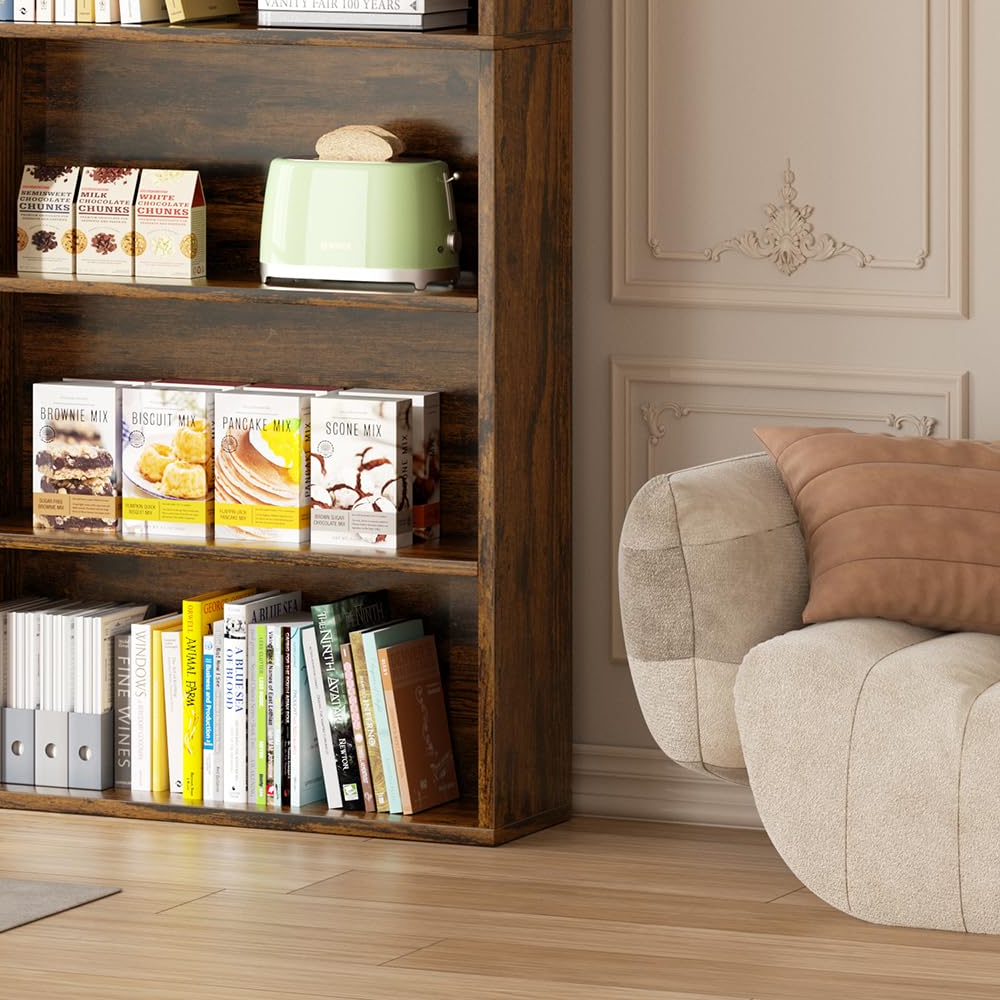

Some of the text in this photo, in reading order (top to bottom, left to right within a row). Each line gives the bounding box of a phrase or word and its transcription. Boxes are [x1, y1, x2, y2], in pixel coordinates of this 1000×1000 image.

[363, 0, 401, 11] YEARS
[20, 203, 70, 211] CHUNKS
[78, 205, 130, 214] CHUNKS
[137, 207, 189, 215] CHUNKS
[40, 406, 108, 423] BROWNIE MIX
[132, 411, 196, 428] BISCUIT MIX
[222, 416, 292, 432] PANCAKE MIX
[325, 421, 382, 438] SCONE MIX
[186, 604, 194, 634] ORWELL
[252, 599, 298, 624] A BLUE SEA
[136, 630, 146, 697] WINDOWS
[320, 629, 335, 672] NINTH
[186, 636, 197, 707] ANIMAL FARM
[226, 648, 234, 710] OF BLOOD
[235, 658, 244, 689] BLUE
[118, 656, 130, 768] FINE WINES
[235, 691, 244, 712] SEA
[327, 676, 345, 724] AVATAR
[362, 698, 376, 746] INFERNO
[338, 738, 350, 770] NEWTON
